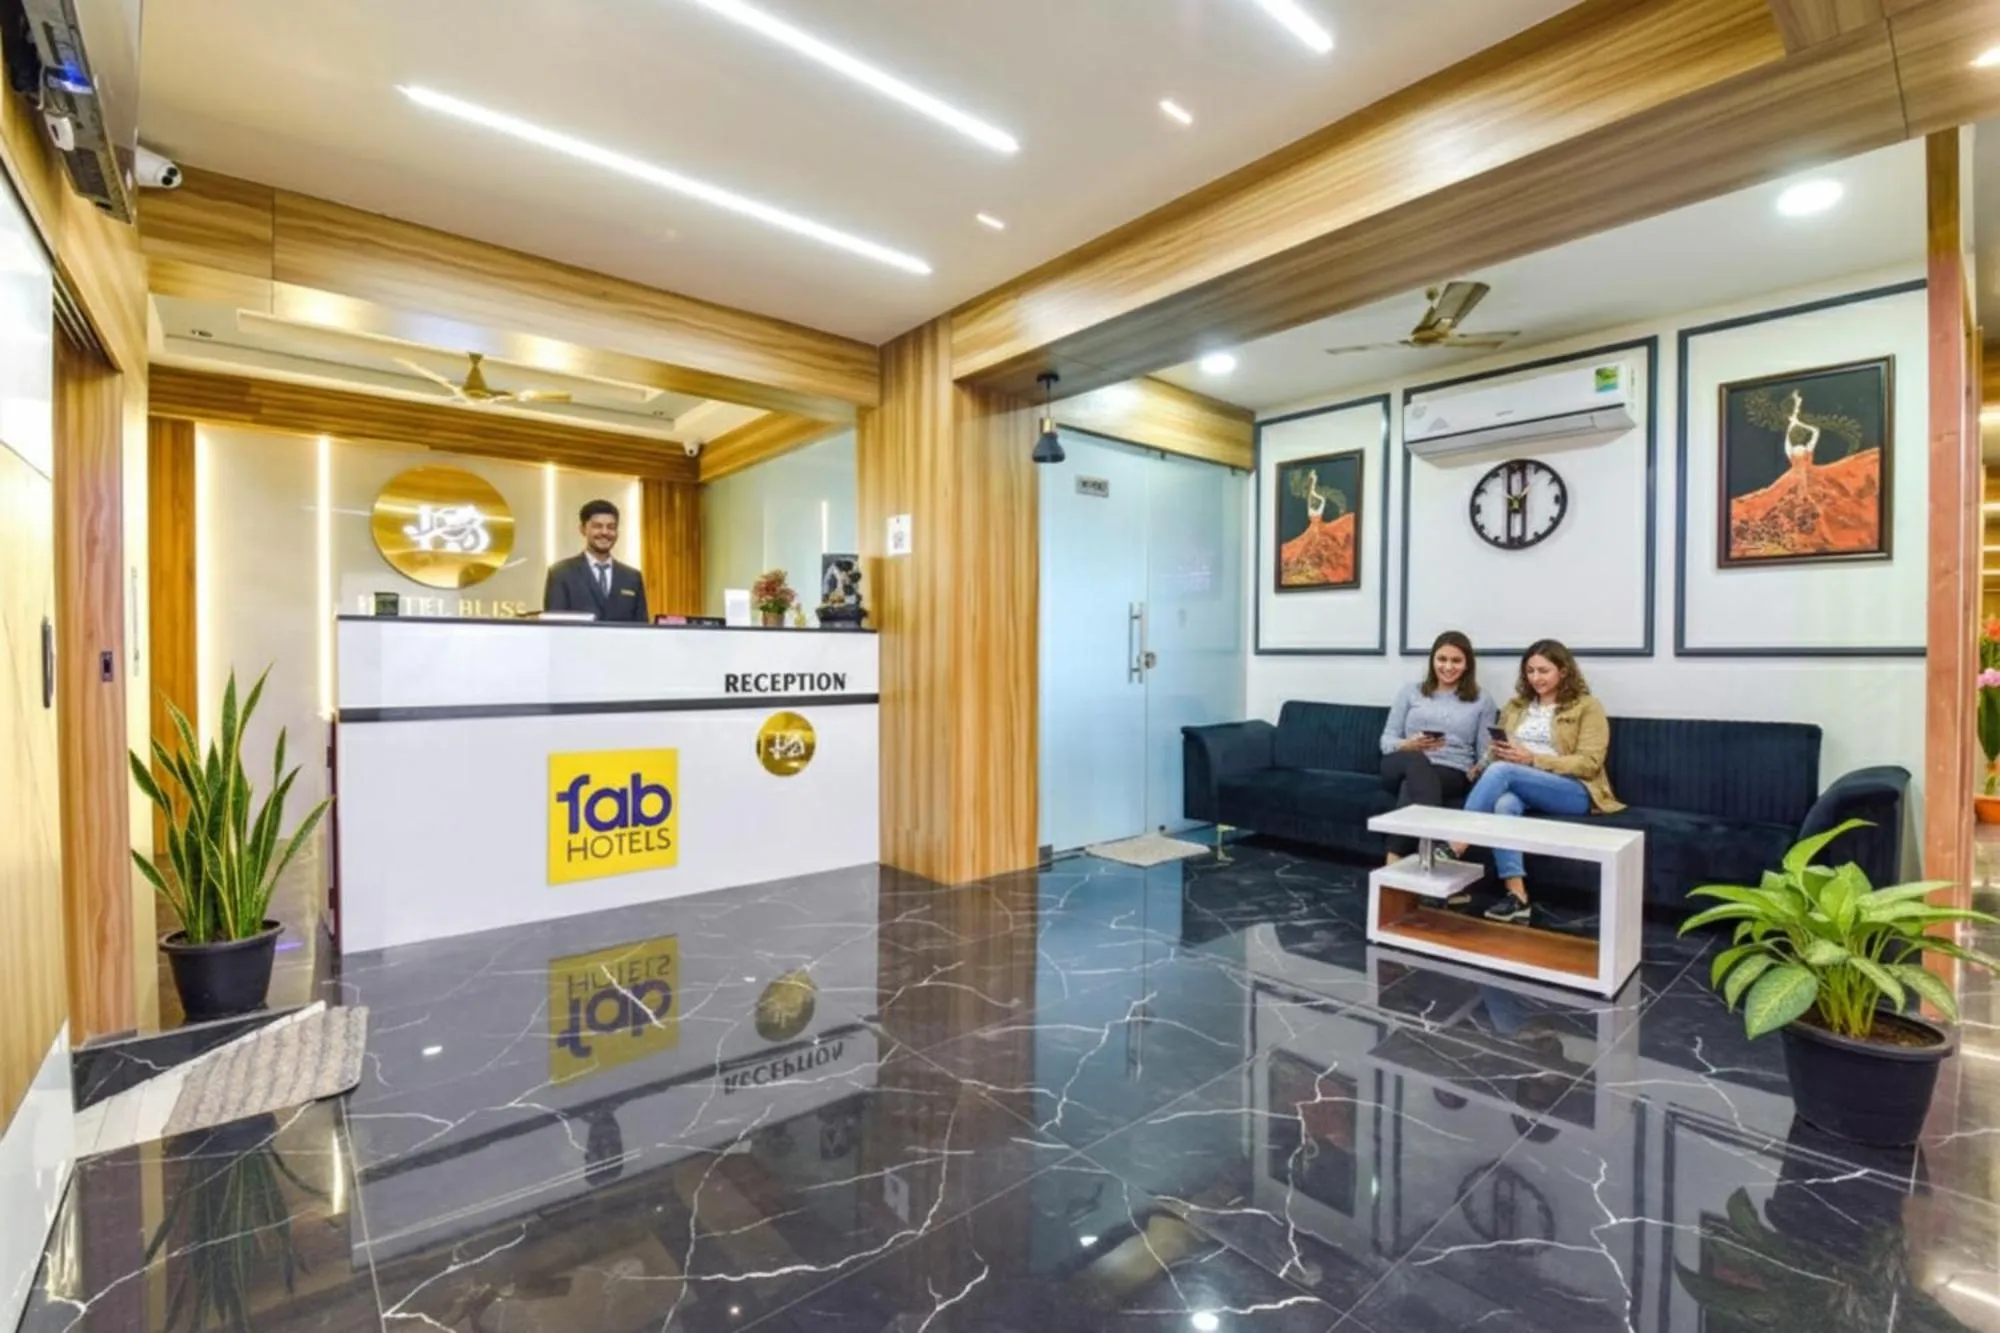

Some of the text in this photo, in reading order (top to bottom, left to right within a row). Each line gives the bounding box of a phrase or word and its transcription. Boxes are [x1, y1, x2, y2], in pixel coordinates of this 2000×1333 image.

[357, 594, 452, 617] HTEL
[724, 672, 846, 693] RECEPTION
[556, 773, 673, 834] fab
[567, 828, 671, 862] HOTELS
